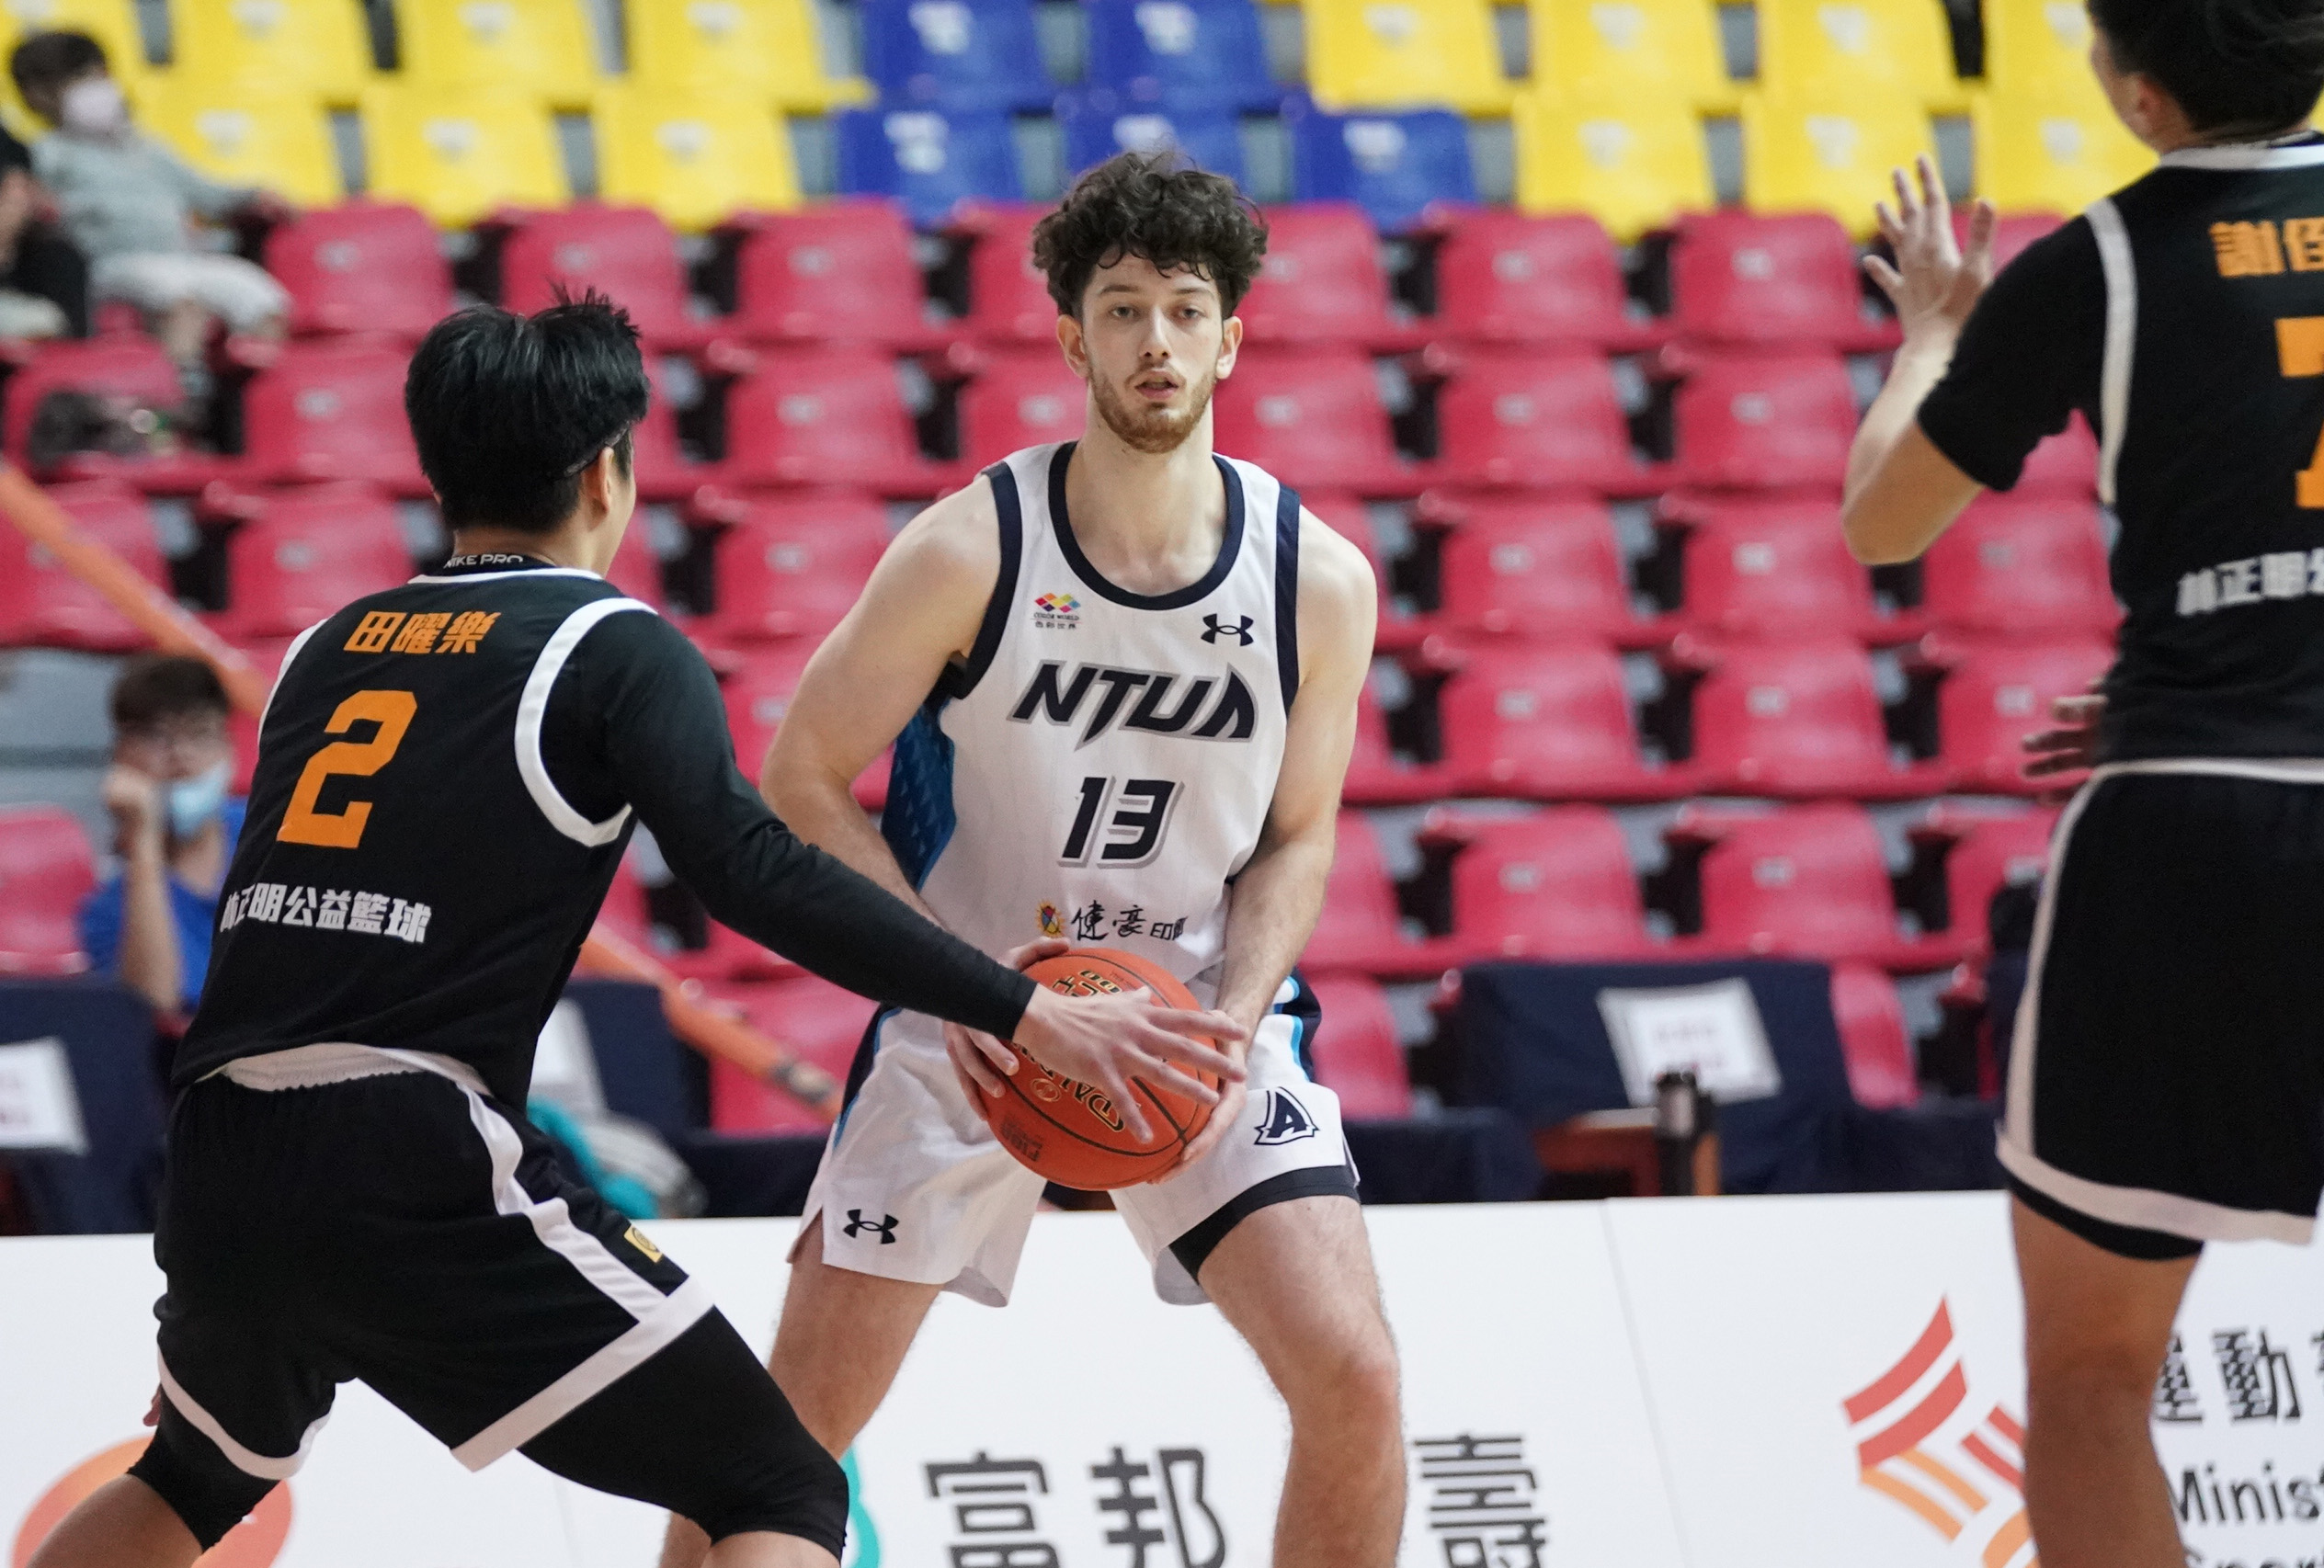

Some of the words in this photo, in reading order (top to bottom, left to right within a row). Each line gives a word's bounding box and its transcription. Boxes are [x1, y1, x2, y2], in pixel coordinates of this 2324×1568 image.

[1006, 659, 1259, 753] NTUA
[276, 690, 417, 849] 2
[1057, 776, 1186, 869] 13
